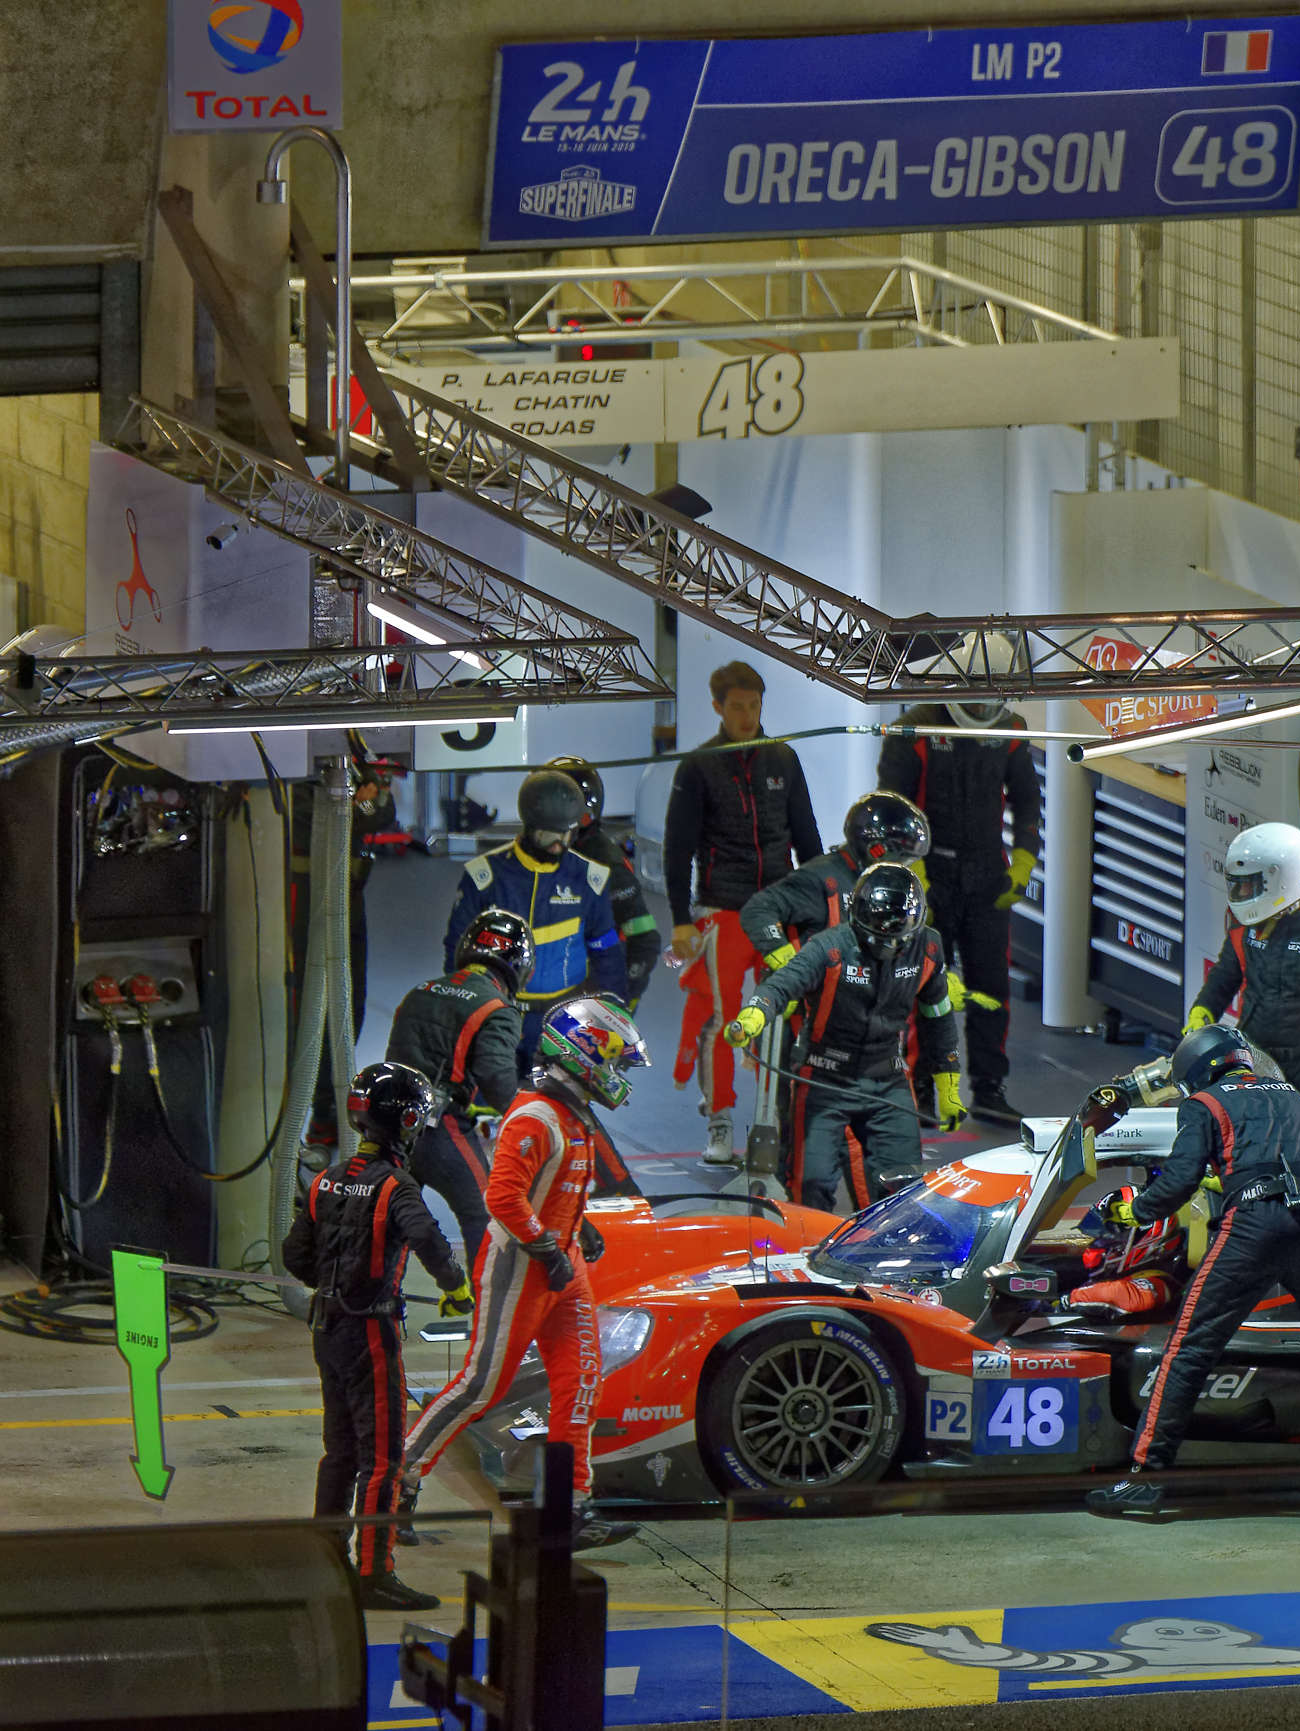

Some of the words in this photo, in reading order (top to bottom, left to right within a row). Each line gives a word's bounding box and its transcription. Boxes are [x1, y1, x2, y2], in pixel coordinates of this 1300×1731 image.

[971, 43, 1013, 82] LM
[1027, 42, 1061, 80] P2
[186, 91, 327, 120] TOTAL
[527, 60, 651, 123] 24h
[521, 125, 557, 142] LE
[560, 124, 641, 141] MANS
[723, 130, 1126, 205] ORECA-GIBSON
[1170, 121, 1278, 189] 48
[521, 179, 635, 219] SUPERFINALE
[441, 373, 463, 388] P.
[484, 368, 627, 387] LAFARGUE
[699, 352, 805, 439] 48
[513, 394, 611, 411] CHATIN
[1140, 928, 1173, 961] SPORT
[1116, 1128, 1143, 1138] Park
[126, 1330, 159, 1350] ENGINE
[575, 1298, 599, 1372] SPORT
[836, 1329, 891, 1380] MICHELIN
[1013, 1357, 1076, 1370] TOTAL
[570, 1373, 600, 1425] IDEC
[622, 1404, 684, 1422] MOTUL
[929, 1400, 968, 1433] P2
[988, 1386, 1065, 1448] 48
[723, 1451, 763, 1490] CHELIN
